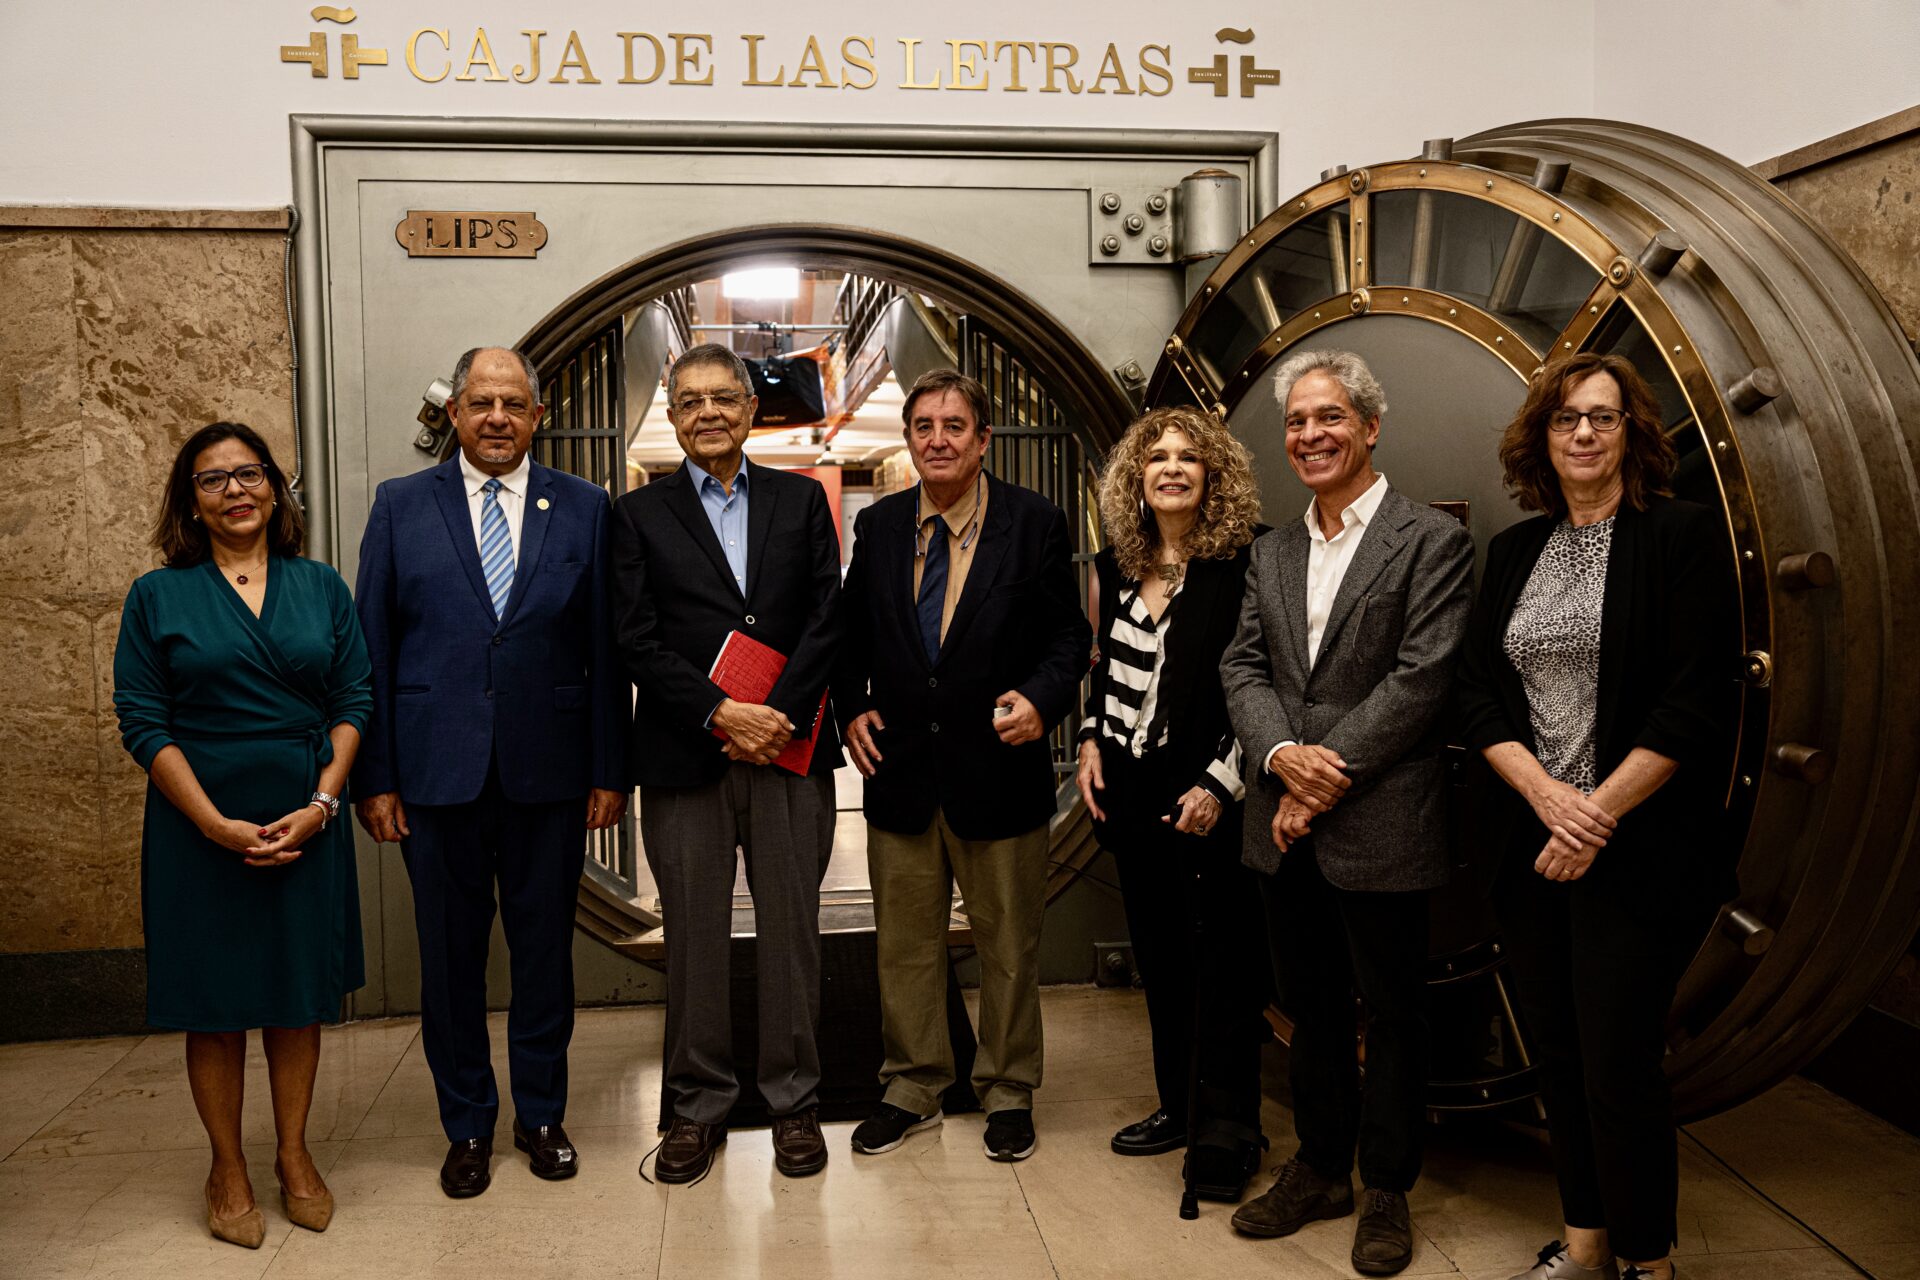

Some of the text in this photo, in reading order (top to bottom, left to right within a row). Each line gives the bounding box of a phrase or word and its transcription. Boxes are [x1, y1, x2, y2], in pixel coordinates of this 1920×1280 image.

[405, 26, 1174, 97] CAJA DE LAS LETRAS
[425, 217, 519, 249] LIPS
